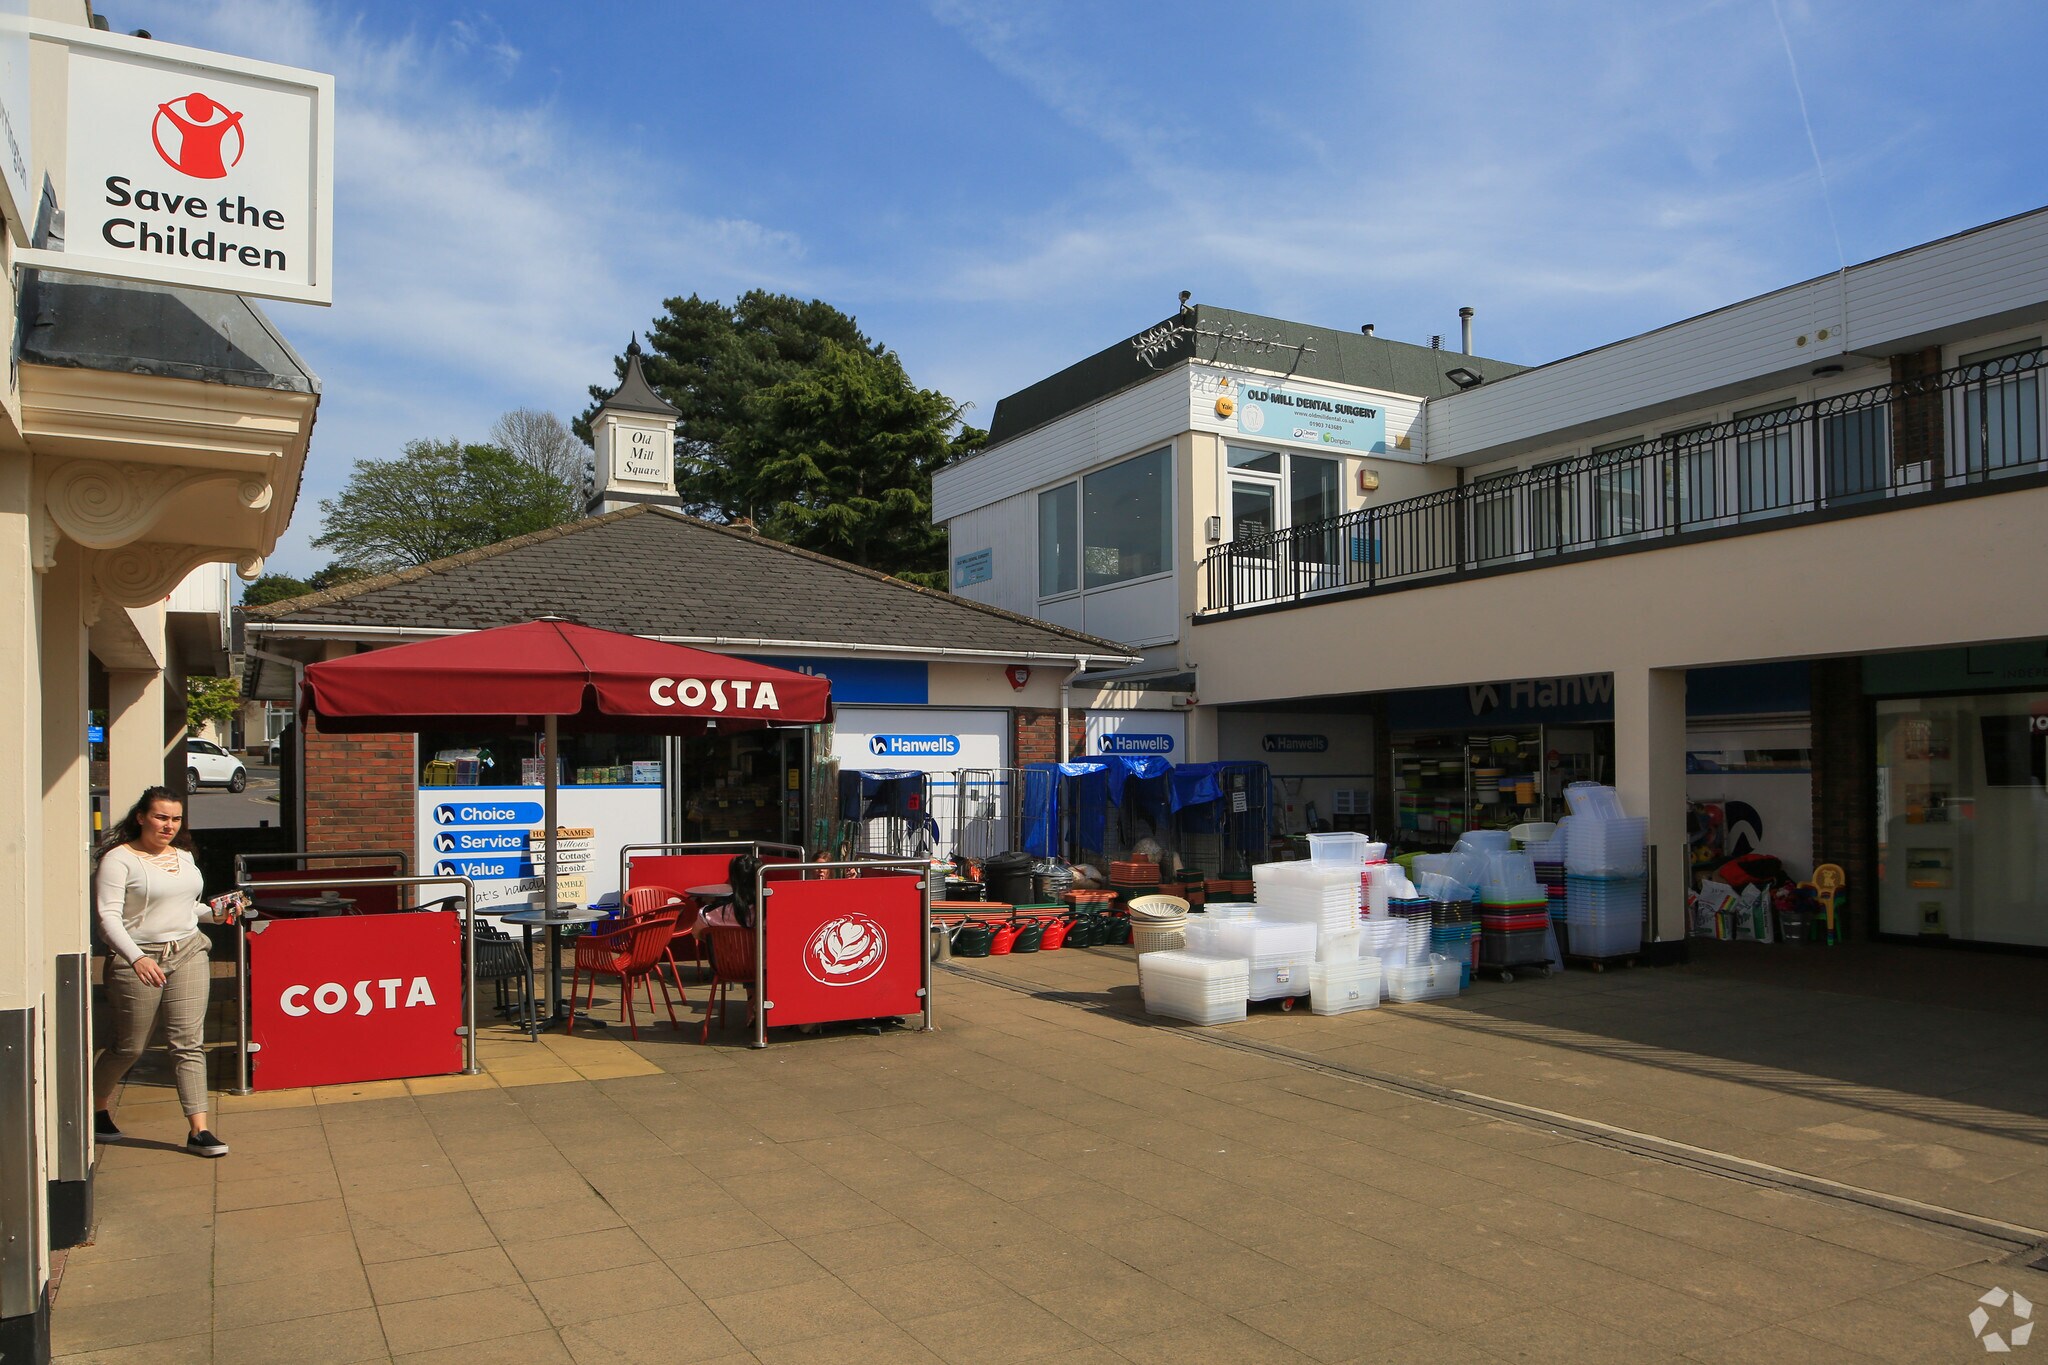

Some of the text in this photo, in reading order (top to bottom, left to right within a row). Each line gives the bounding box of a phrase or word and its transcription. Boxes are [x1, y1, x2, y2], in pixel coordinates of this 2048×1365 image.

[105, 175, 285, 231] Save the
[102, 217, 287, 271] Children
[1221, 402, 1233, 411] Yale
[1247, 389, 1377, 419] OLD MILL DENTAL SURGERY
[1294, 411, 1355, 424] www.oldmilldental.co.uk
[631, 431, 652, 445] Old
[629, 446, 654, 461] Mill
[623, 460, 660, 476] Square
[649, 677, 779, 712] COSTA
[1509, 674, 1615, 709] Hanw
[891, 737, 955, 753] Hanwells
[1116, 736, 1170, 751] Hanwells
[1277, 736, 1325, 750] Hanwells
[460, 807, 516, 821] Choice
[564, 829, 591, 837] NAMES
[461, 834, 522, 849] Service
[559, 852, 591, 861] Cottage
[461, 862, 505, 877] Value
[280, 976, 437, 1017] COSTA
